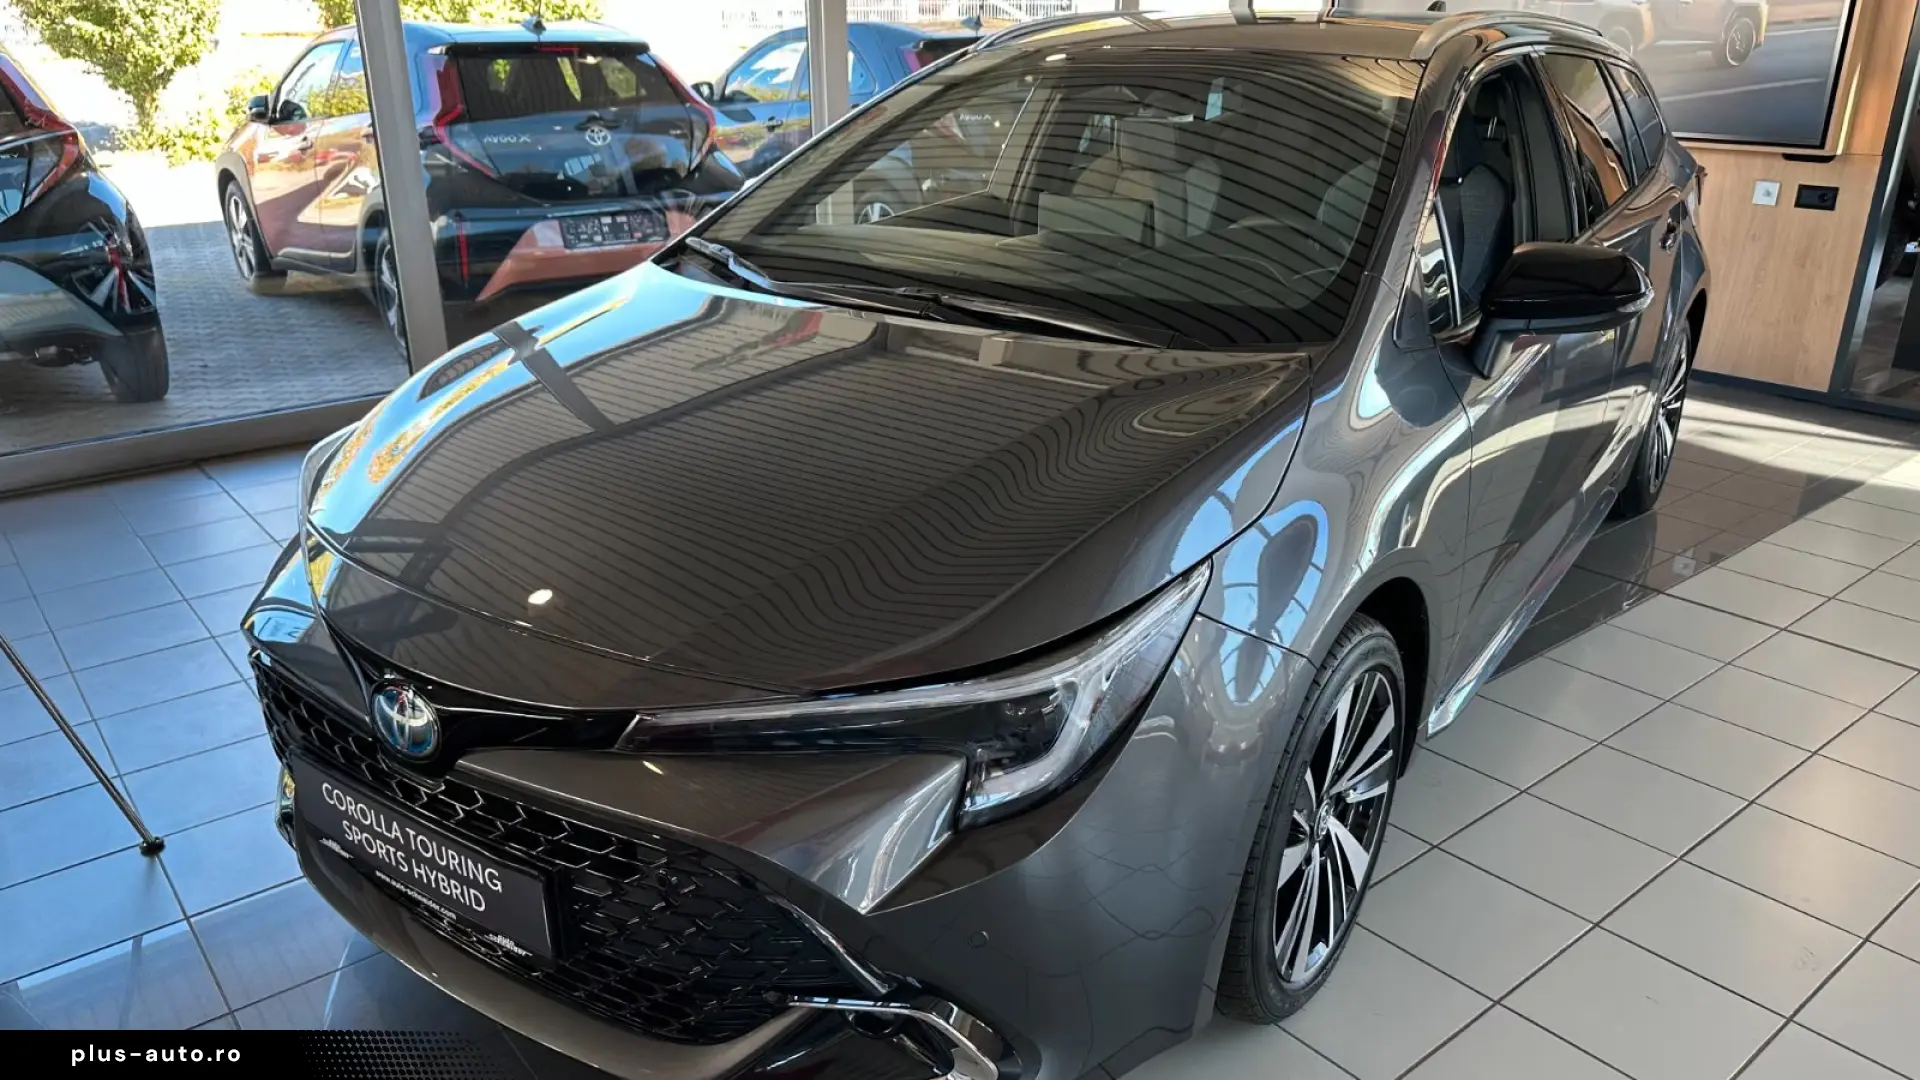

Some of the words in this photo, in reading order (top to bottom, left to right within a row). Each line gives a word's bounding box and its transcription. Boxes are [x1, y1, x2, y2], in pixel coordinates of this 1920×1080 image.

[322, 782, 404, 845] COROLLA
[405, 827, 503, 894] TOURING
[342, 820, 409, 873] SPORTS
[412, 858, 486, 912] HYBRID
